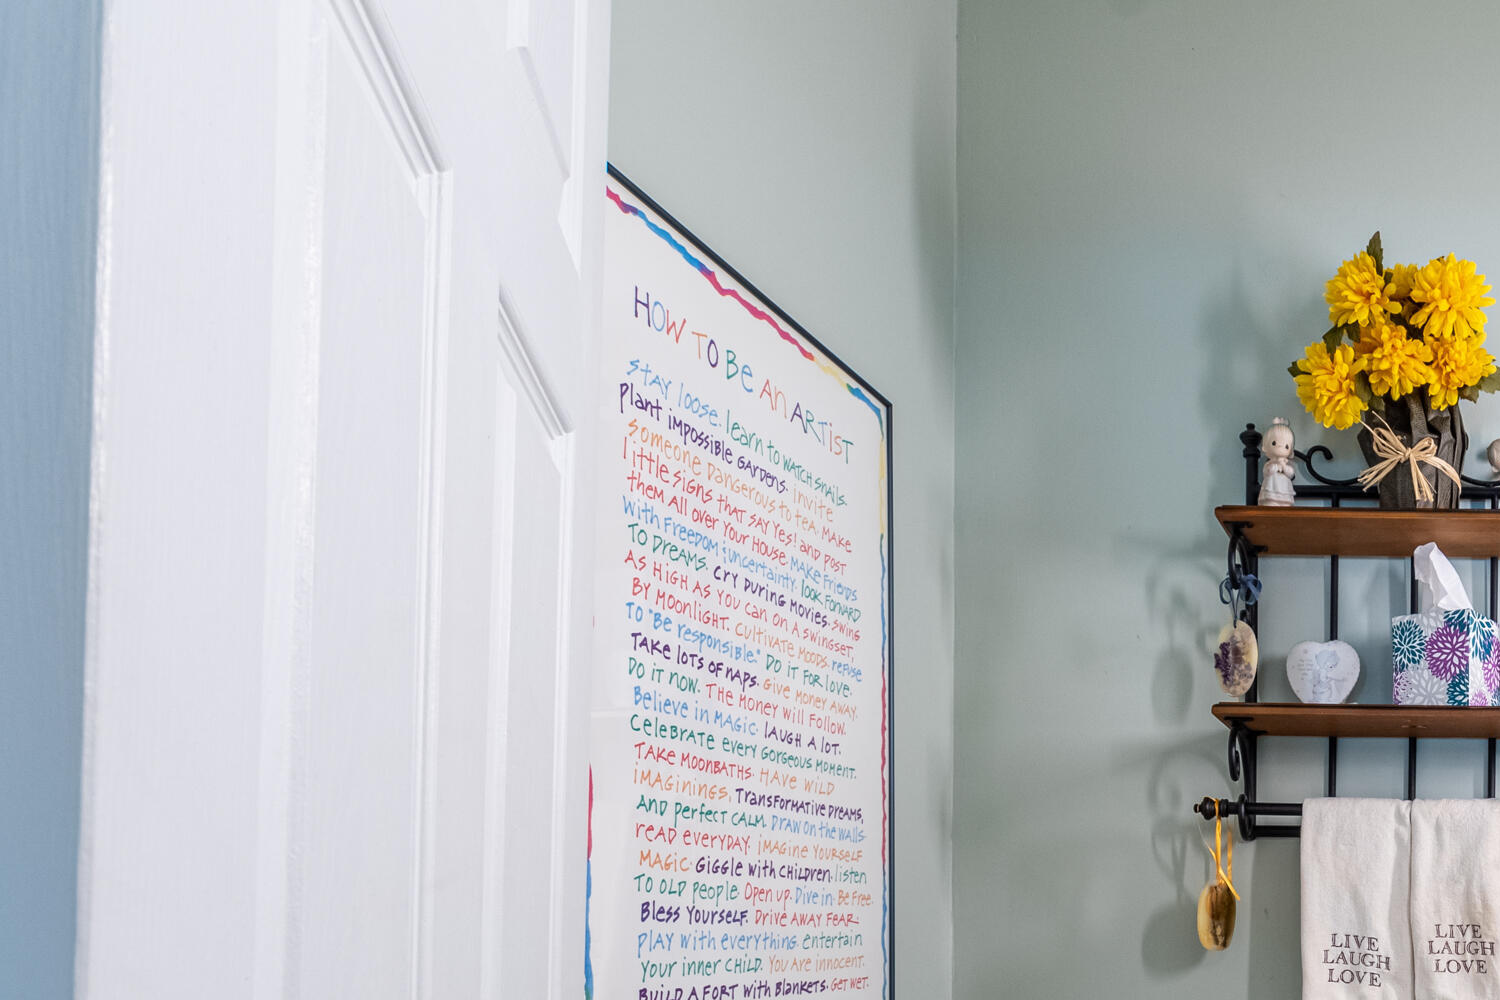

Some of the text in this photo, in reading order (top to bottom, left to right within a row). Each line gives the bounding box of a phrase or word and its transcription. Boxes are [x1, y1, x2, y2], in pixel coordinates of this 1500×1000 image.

[634, 285, 686, 344] HOW
[692, 330, 719, 368] TO
[807, 736, 817, 750] A
[1435, 924, 1482, 938] LIVE
[1331, 933, 1379, 951] LIVE
[1428, 940, 1495, 956] LAUGH
[1323, 949, 1390, 971] LAUGH
[1434, 959, 1487, 974] LOVE
[1328, 968, 1381, 987] LOVE
